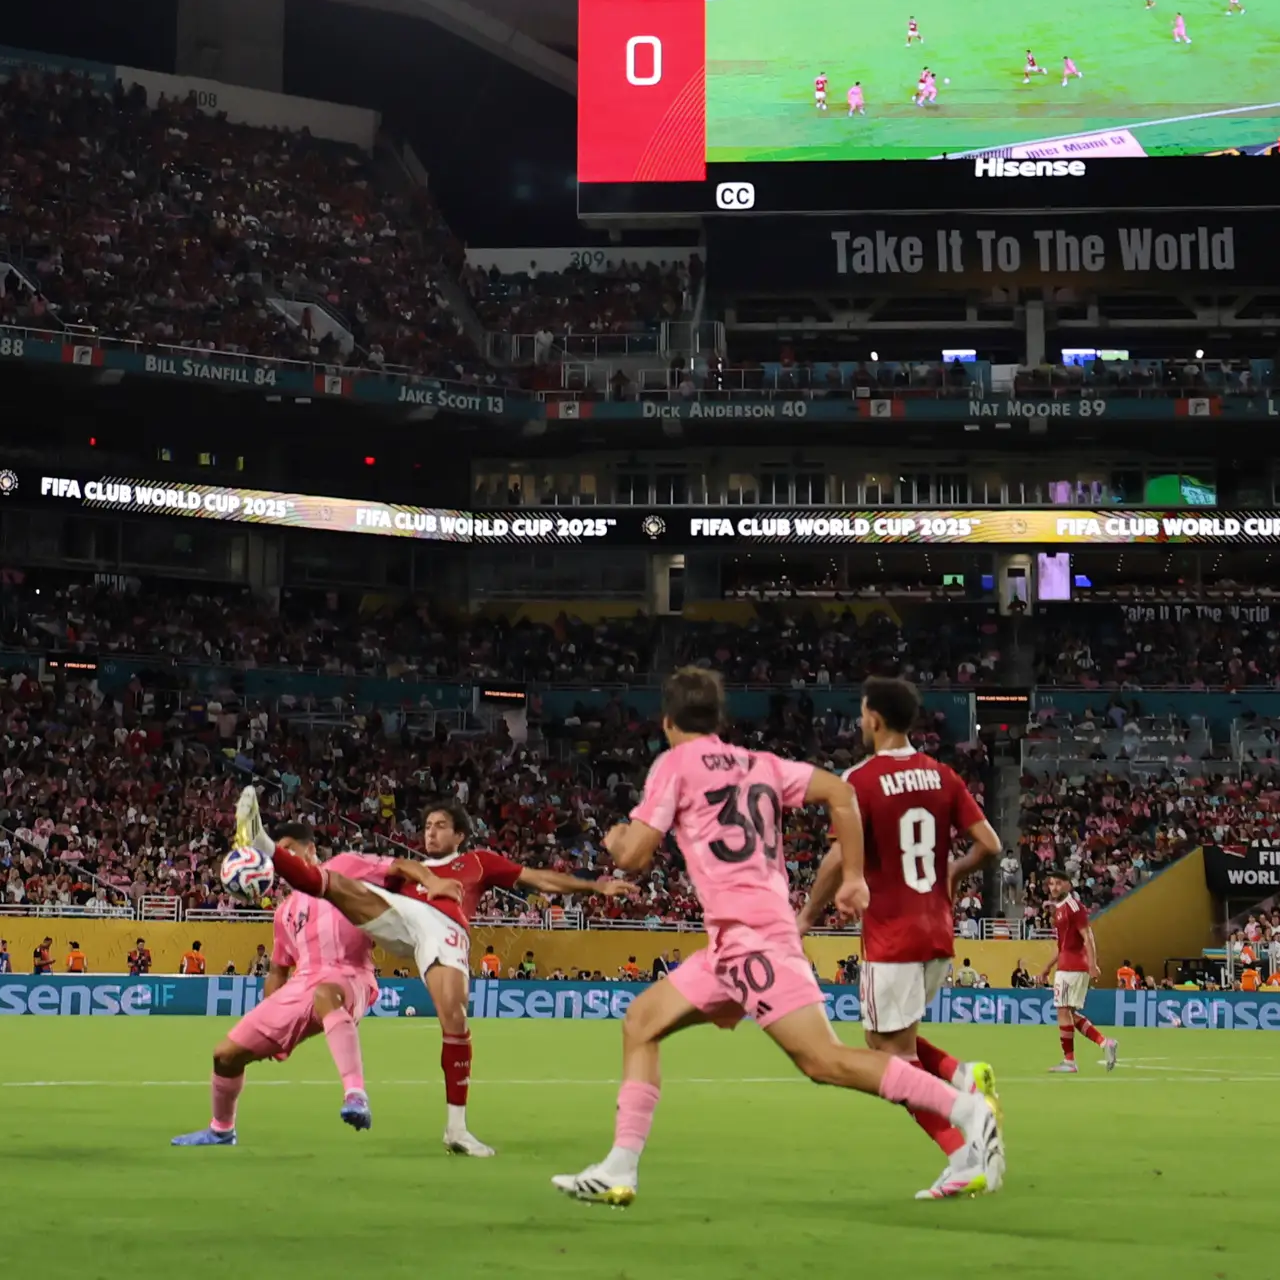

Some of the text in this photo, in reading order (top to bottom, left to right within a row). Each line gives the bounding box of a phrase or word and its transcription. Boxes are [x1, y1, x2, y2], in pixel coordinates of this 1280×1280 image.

[625, 35, 663, 86] 0
[1062, 138, 1109, 154] Miami
[974, 158, 1086, 178] Hisense
[570, 251, 605, 268] 309
[830, 226, 1235, 274] Take It To The World
[0, 337, 25, 357] 88
[144, 354, 277, 387] BILL STANFILL 84
[397, 385, 505, 414] JAKE SCOTT 13
[642, 400, 808, 419] DICK ANDERSON 40
[969, 399, 1106, 417] NAT MOORE 89
[355, 508, 392, 529] FIFA
[395, 512, 437, 533] CLUB
[440, 516, 509, 537] WORLD
[512, 519, 555, 538] CUP
[690, 518, 735, 537] FIFA
[737, 518, 792, 537] CLUB
[795, 518, 870, 537] WORLD
[873, 518, 917, 537] CUP
[1056, 518, 1101, 537] FIFA
[1105, 518, 1159, 537] CLUB
[1163, 518, 1240, 537] WORLD
[704, 783, 782, 863] 30
[899, 806, 937, 894] 8
